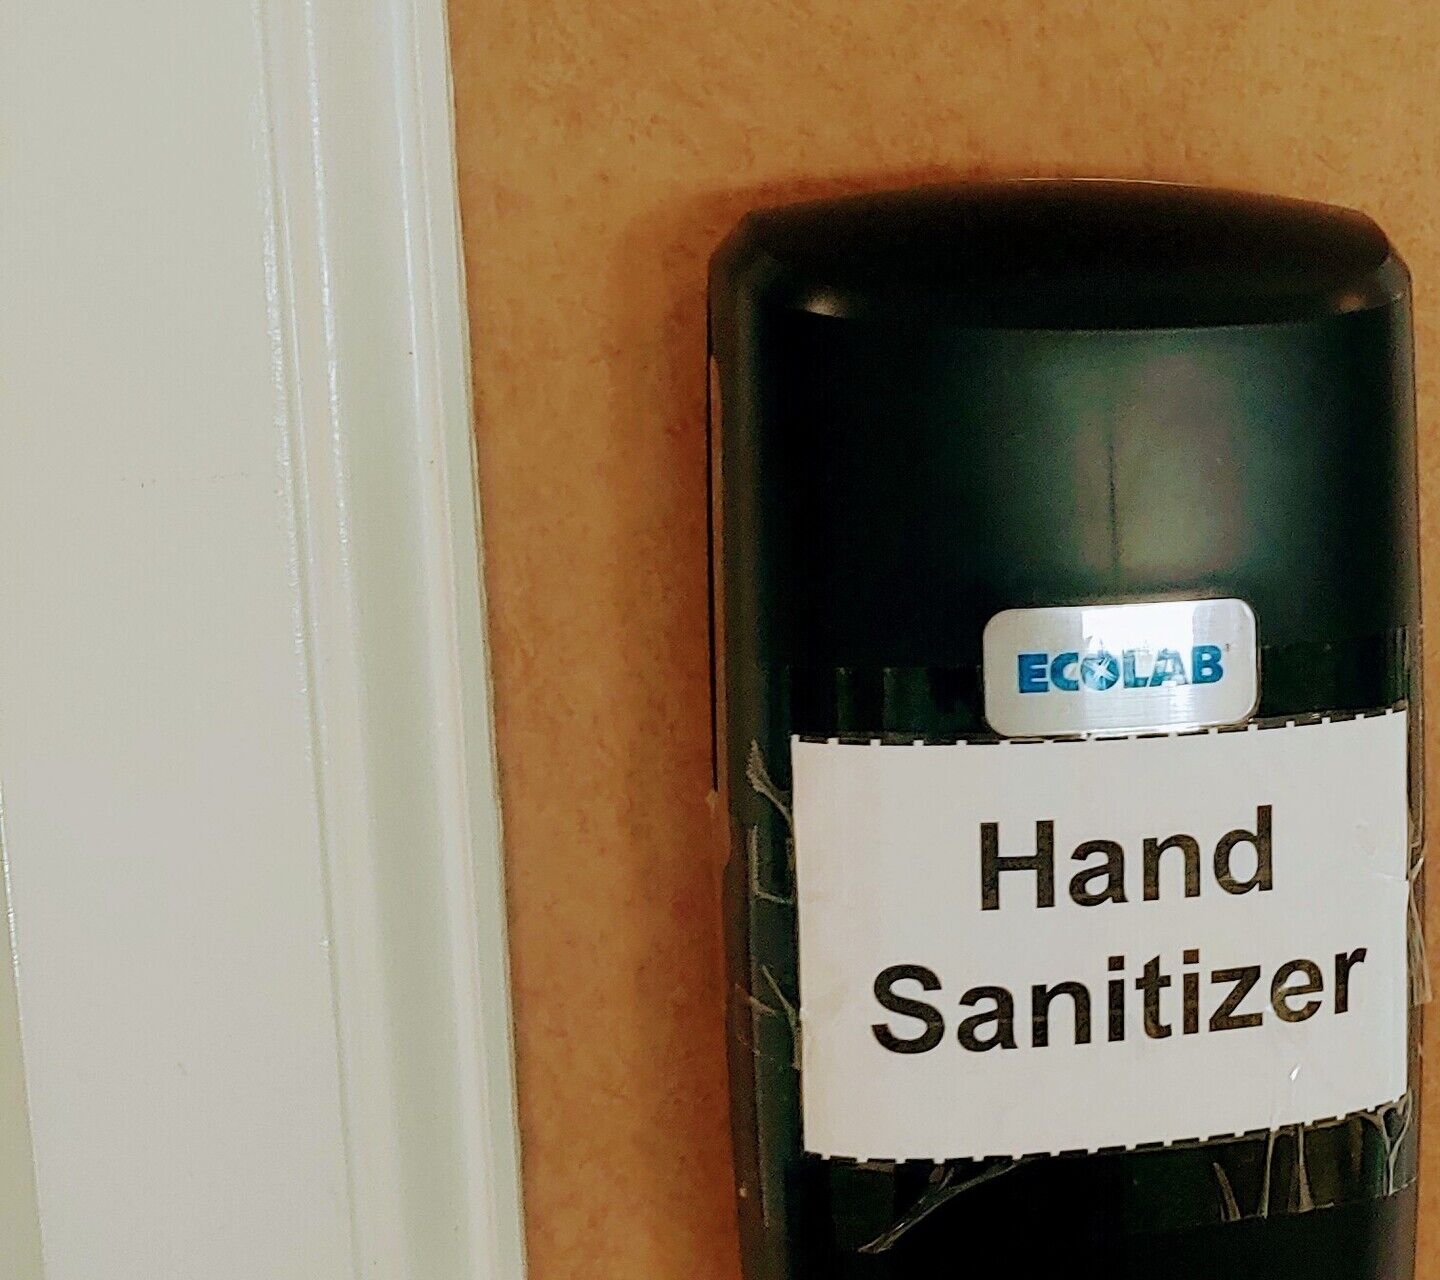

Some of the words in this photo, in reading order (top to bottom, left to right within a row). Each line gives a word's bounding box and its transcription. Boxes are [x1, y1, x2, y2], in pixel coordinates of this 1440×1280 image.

[1017, 644, 1224, 694] ECOLAB
[979, 805, 1274, 910] Hand
[871, 947, 1367, 1054] Sanitizer
